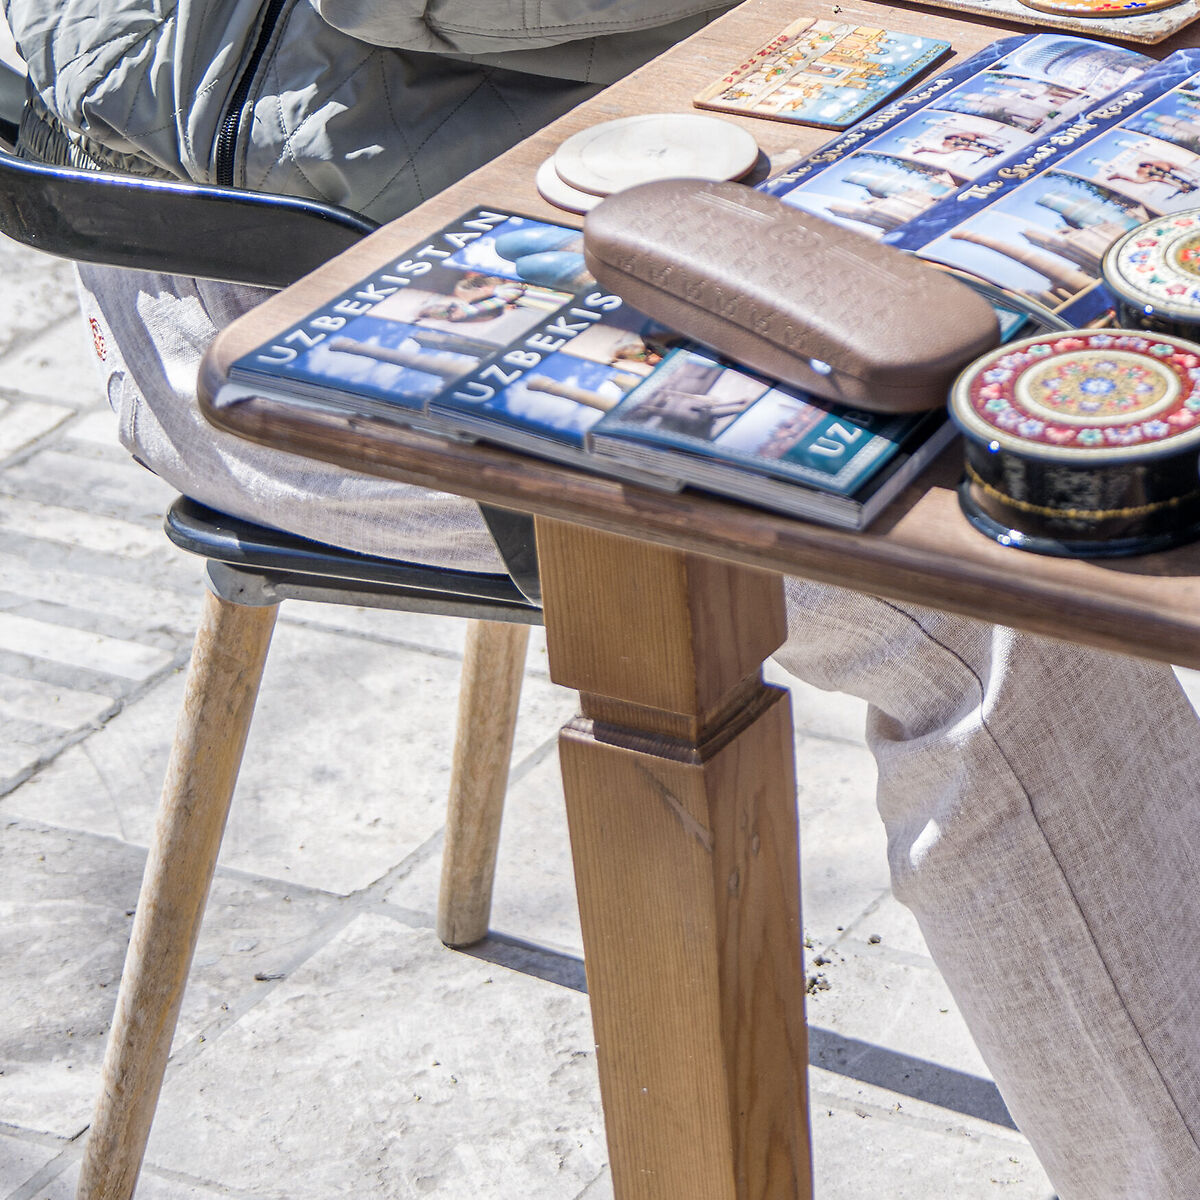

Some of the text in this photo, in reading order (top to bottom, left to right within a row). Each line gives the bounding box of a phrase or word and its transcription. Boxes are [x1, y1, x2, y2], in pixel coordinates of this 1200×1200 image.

[767, 164, 813, 188] The
[808, 131, 866, 163] Great
[861, 106, 907, 131] Silk
[897, 78, 954, 106] Road
[957, 90, 1145, 202] The Great Silk Road
[256, 210, 509, 366] UZBEKISTAN
[452, 292, 623, 404] UZBEKIS
